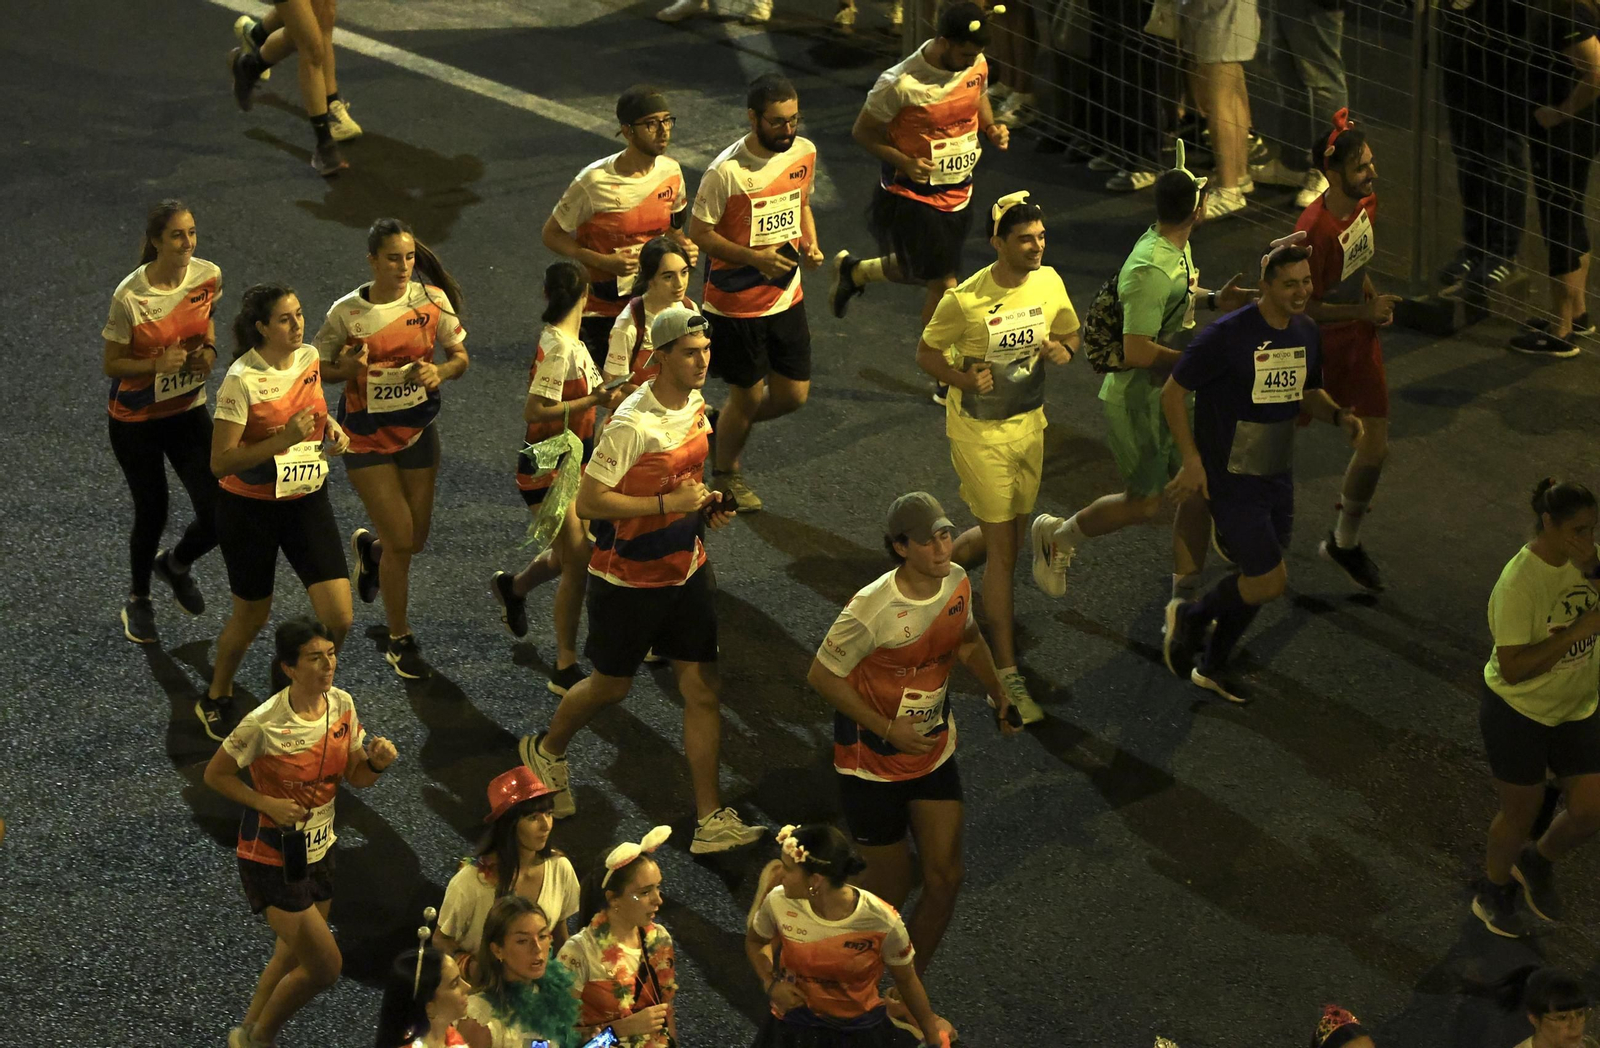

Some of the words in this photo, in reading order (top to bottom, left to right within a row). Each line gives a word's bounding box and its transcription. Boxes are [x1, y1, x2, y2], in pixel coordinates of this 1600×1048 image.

[938, 152, 976, 173] 14039
[790, 169, 805, 180] KH7
[658, 189, 671, 200] KH7
[758, 210, 794, 232] 15363
[1348, 234, 1368, 261] 4342
[190, 290, 206, 304] KH7
[406, 315, 427, 327] KH7
[999, 328, 1034, 348] 4343
[304, 374, 318, 385] KH7
[1264, 370, 1297, 388] 4435
[282, 463, 321, 482] 21771
[949, 601, 962, 616] KH7
